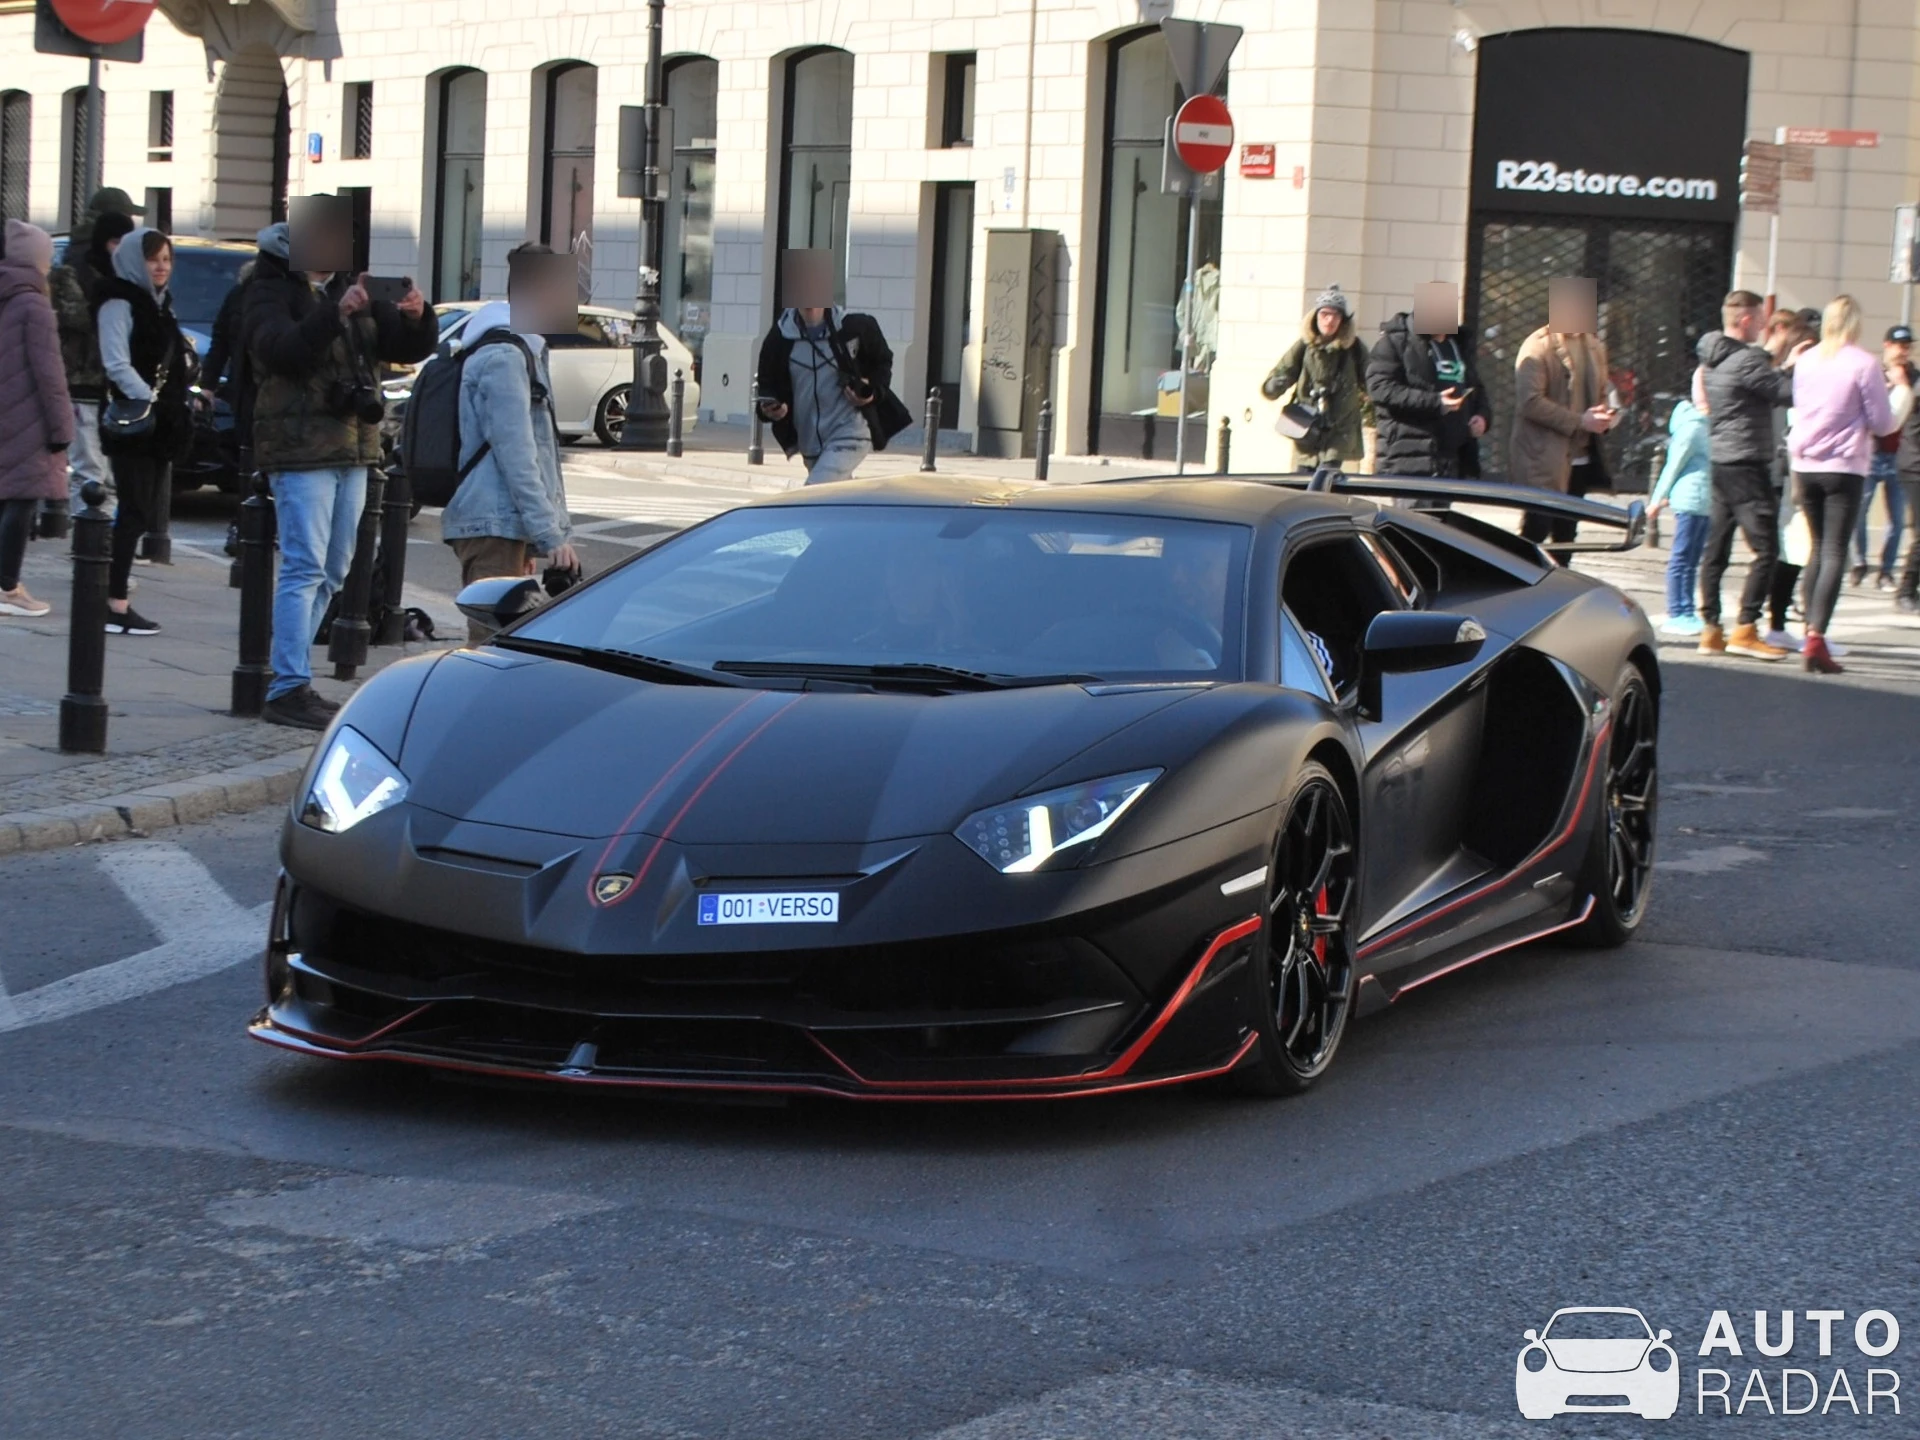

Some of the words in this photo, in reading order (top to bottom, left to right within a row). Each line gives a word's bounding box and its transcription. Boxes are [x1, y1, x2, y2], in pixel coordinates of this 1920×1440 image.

[1496, 160, 1718, 200] R23store.com
[722, 898, 753, 918] 001
[767, 897, 833, 917] VERSO
